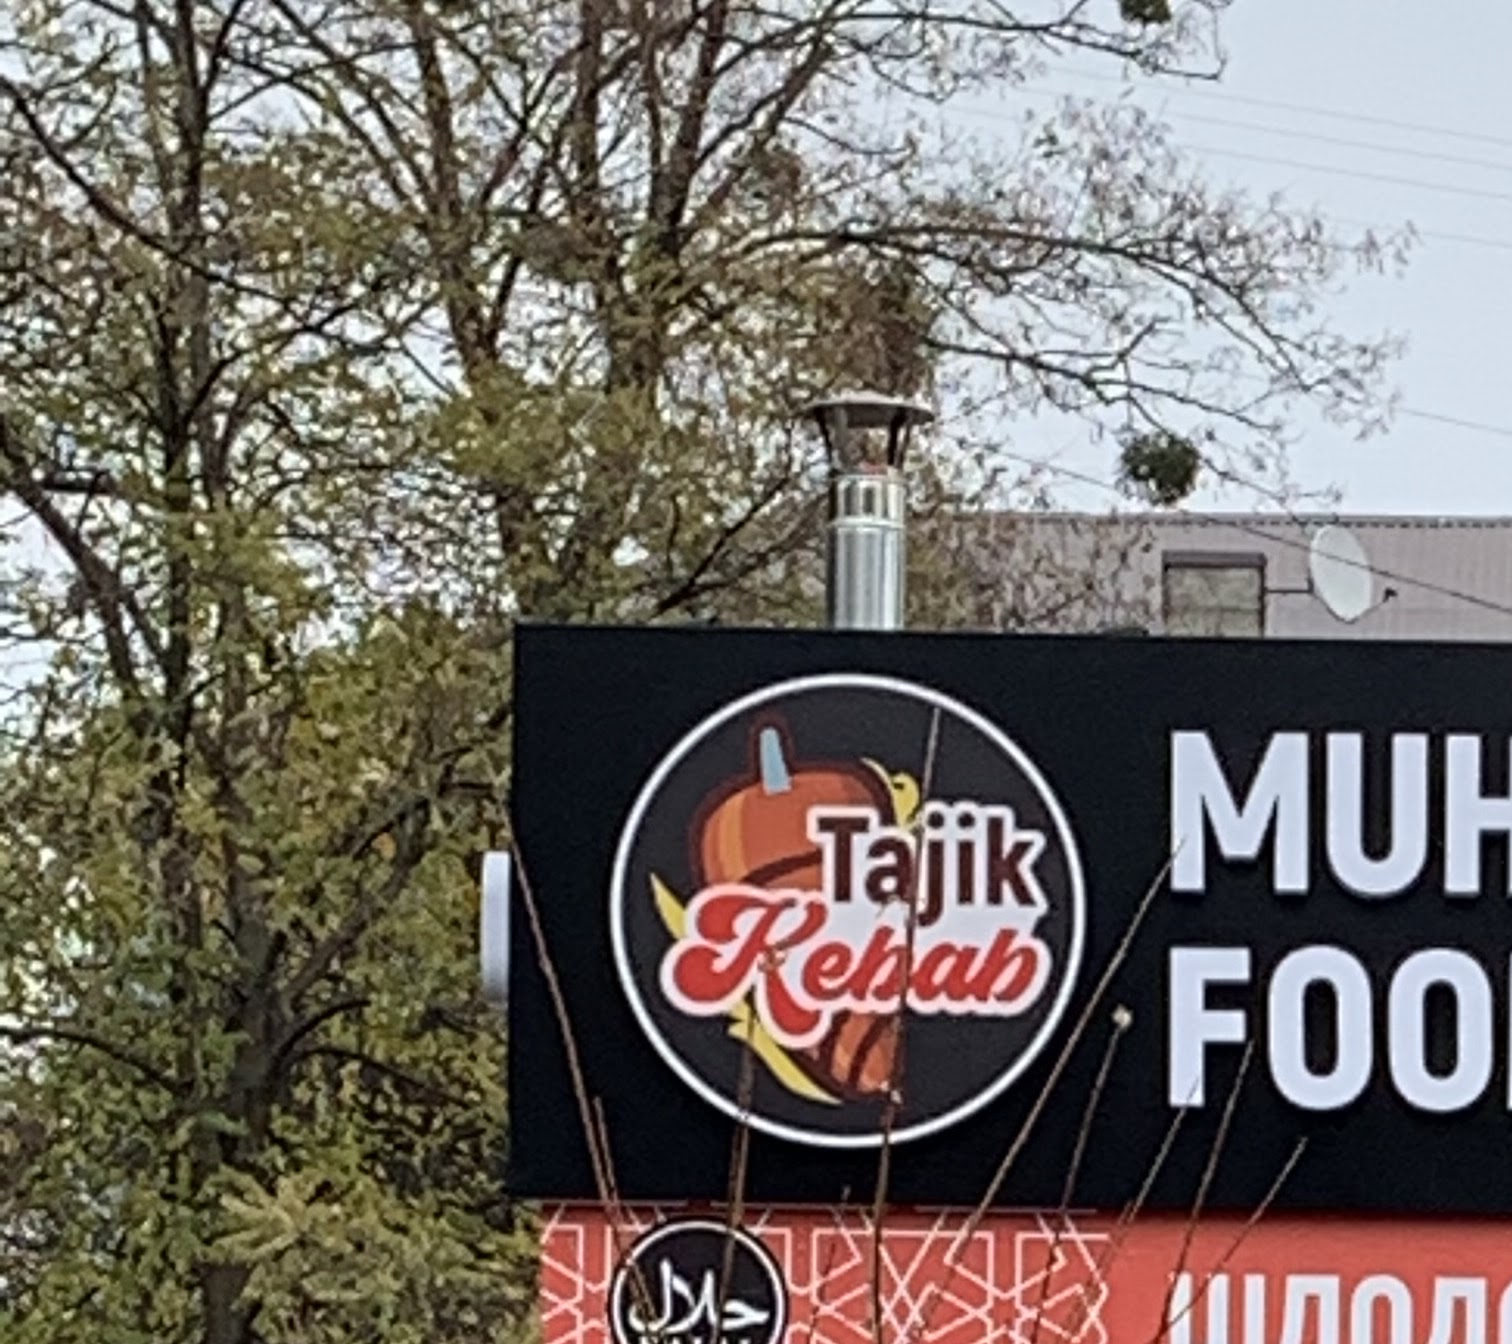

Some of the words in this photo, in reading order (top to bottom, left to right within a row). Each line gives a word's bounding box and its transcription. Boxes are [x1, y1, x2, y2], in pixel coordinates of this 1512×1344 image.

[815, 810, 1040, 927] Tajik
[672, 892, 1044, 1037] Kebab
[628, 1258, 771, 1334] حلال
